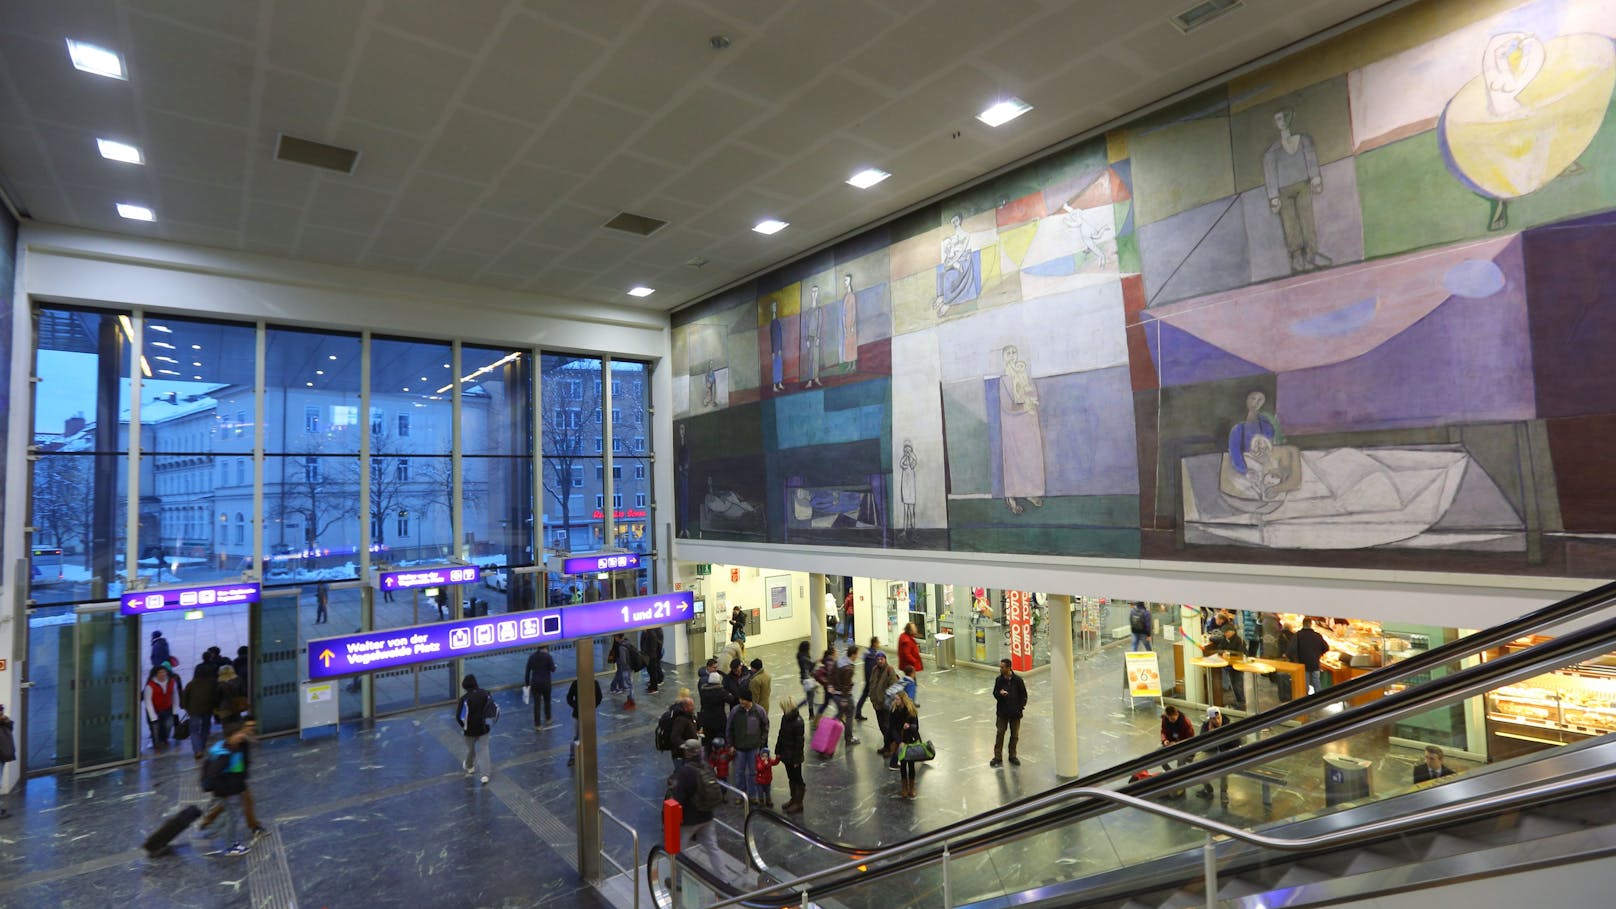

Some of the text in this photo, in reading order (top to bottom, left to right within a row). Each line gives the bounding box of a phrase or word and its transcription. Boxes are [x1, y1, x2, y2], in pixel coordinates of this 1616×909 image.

[621, 600, 670, 623] 1 und 21
[1022, 591, 1030, 620] TOTO
[1010, 590, 1022, 657] LOTTO TOTO
[346, 634, 428, 653] Walter von der
[346, 642, 440, 664] Vogelweide Platz
